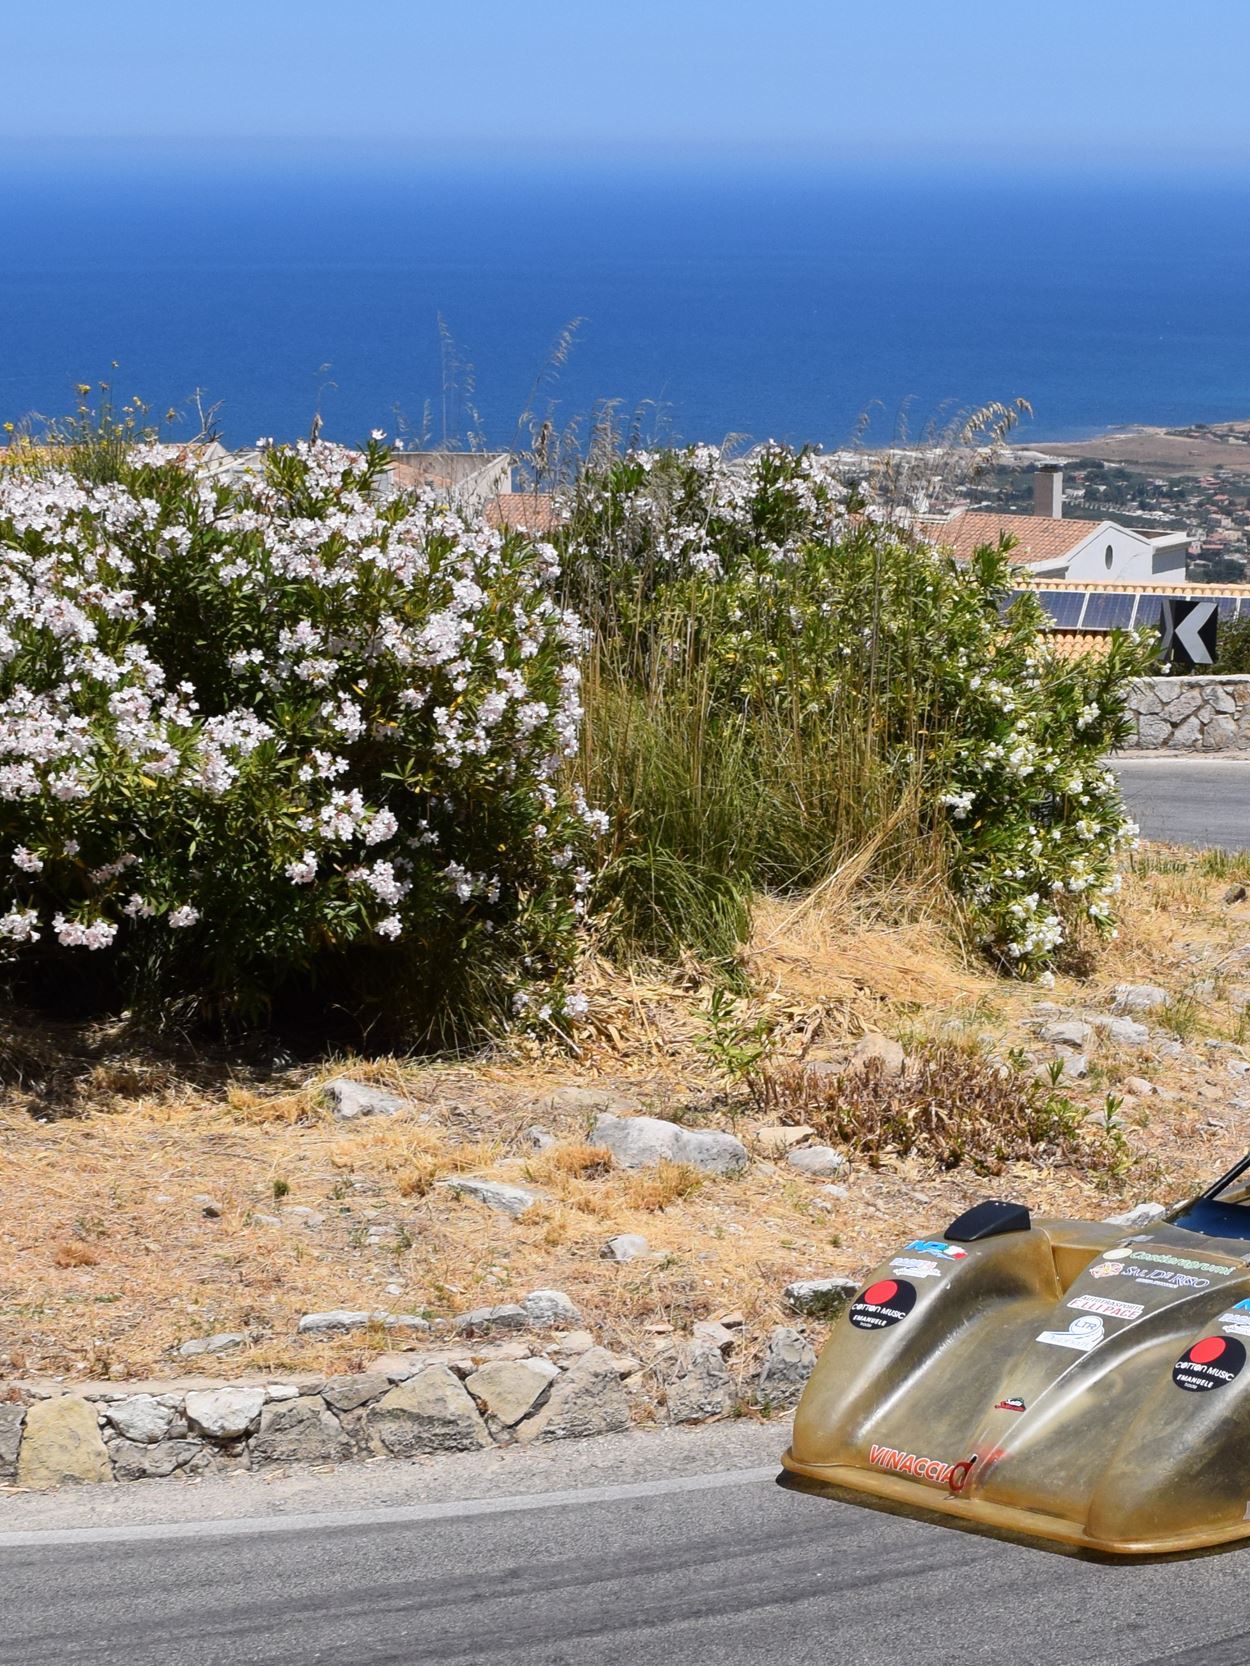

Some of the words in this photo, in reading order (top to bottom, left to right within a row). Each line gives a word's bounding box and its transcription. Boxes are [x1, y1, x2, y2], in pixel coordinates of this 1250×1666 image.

[1169, 1273, 1210, 1288] RISO
[1070, 1300, 1102, 1310] F.LLI
[1102, 1305, 1140, 1319] PACE
[1081, 1296, 1143, 1310] AUTOTRASPORTI
[852, 1314, 887, 1326] EMANUELE
[881, 1307, 906, 1319] MUSIC
[1074, 1320, 1097, 1329] LTR
[1176, 1373, 1214, 1388] EMANUELE
[1207, 1366, 1235, 1381] MUSIC
[869, 1444, 951, 1484] VINACCIA
